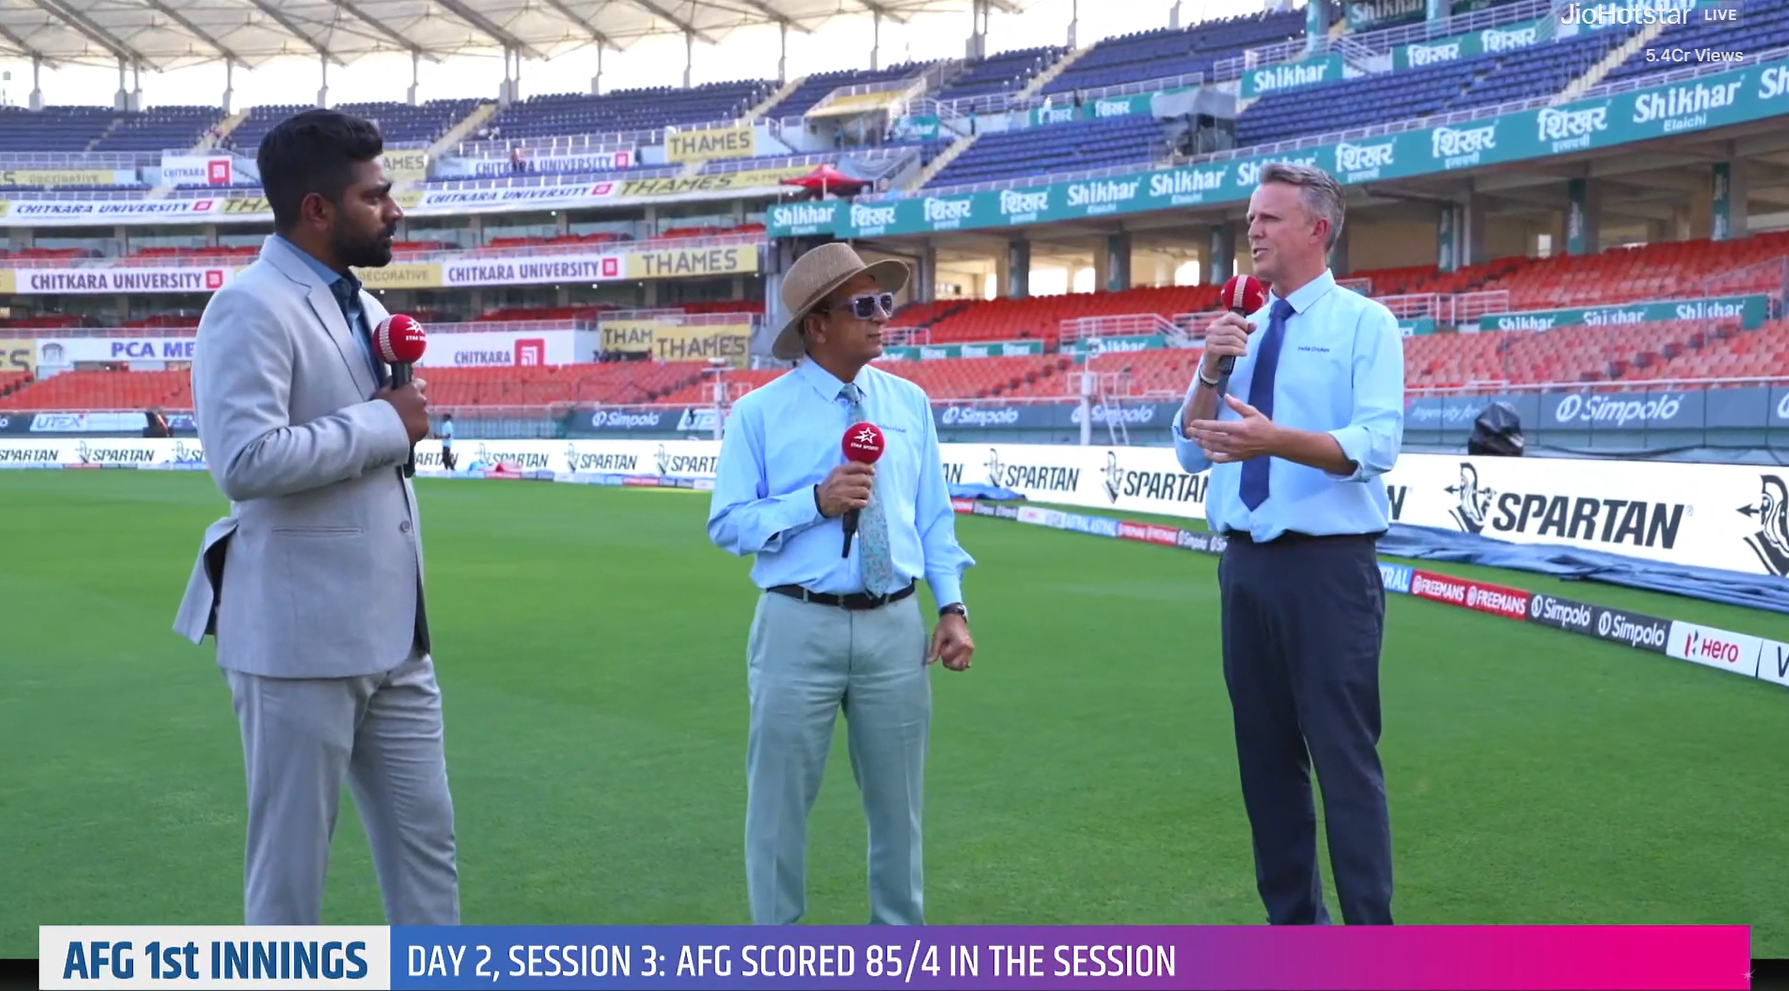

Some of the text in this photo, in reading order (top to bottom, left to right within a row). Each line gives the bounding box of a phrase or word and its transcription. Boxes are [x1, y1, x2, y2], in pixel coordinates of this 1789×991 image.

[1253, 64, 1327, 93] Shikhar
[1632, 80, 1742, 124] Shikhar
[1537, 105, 1608, 142] शिखर
[1664, 112, 1707, 132] Elaichi
[669, 131, 751, 155] THAMES
[1433, 127, 1498, 158] शिखर
[383, 155, 425, 170] AMES
[1335, 142, 1395, 173] शिखर
[163, 167, 206, 179] CHITKARA
[1150, 169, 1227, 197] Shikhar
[426, 191, 498, 204] CHITKARA
[502, 186, 590, 201] UNIVERSITY
[620, 174, 736, 197] THAMES
[1067, 180, 1140, 206] Shikhar
[98, 202, 191, 213] UNIVERSITY
[773, 205, 836, 227] Shikhar
[448, 260, 599, 282] CHITKARA UNIVERSITY
[642, 250, 738, 274] THAMES
[31, 272, 202, 290] CHITKARA UNIVERSITY
[604, 329, 652, 344] THAM
[657, 335, 746, 359] THAMES
[111, 342, 155, 358] PCA
[454, 350, 511, 365] CHITKARA
[36, 415, 81, 428] UTEX
[1581, 395, 1680, 425] Simpolo
[93, 449, 154, 462] SPARTAN
[580, 454, 638, 471] SPARTAN
[671, 455, 718, 473] SPART
[1005, 465, 1079, 492] SPARTAN
[1492, 493, 1685, 550] SPARTAN
[1380, 566, 1409, 592] TRAL
[1420, 580, 1526, 616] FREEMANS FREEMANS
[1543, 597, 1591, 628] Simpolo
[1611, 614, 1665, 648] Simpolo
[1701, 638, 1739, 663] Hero
